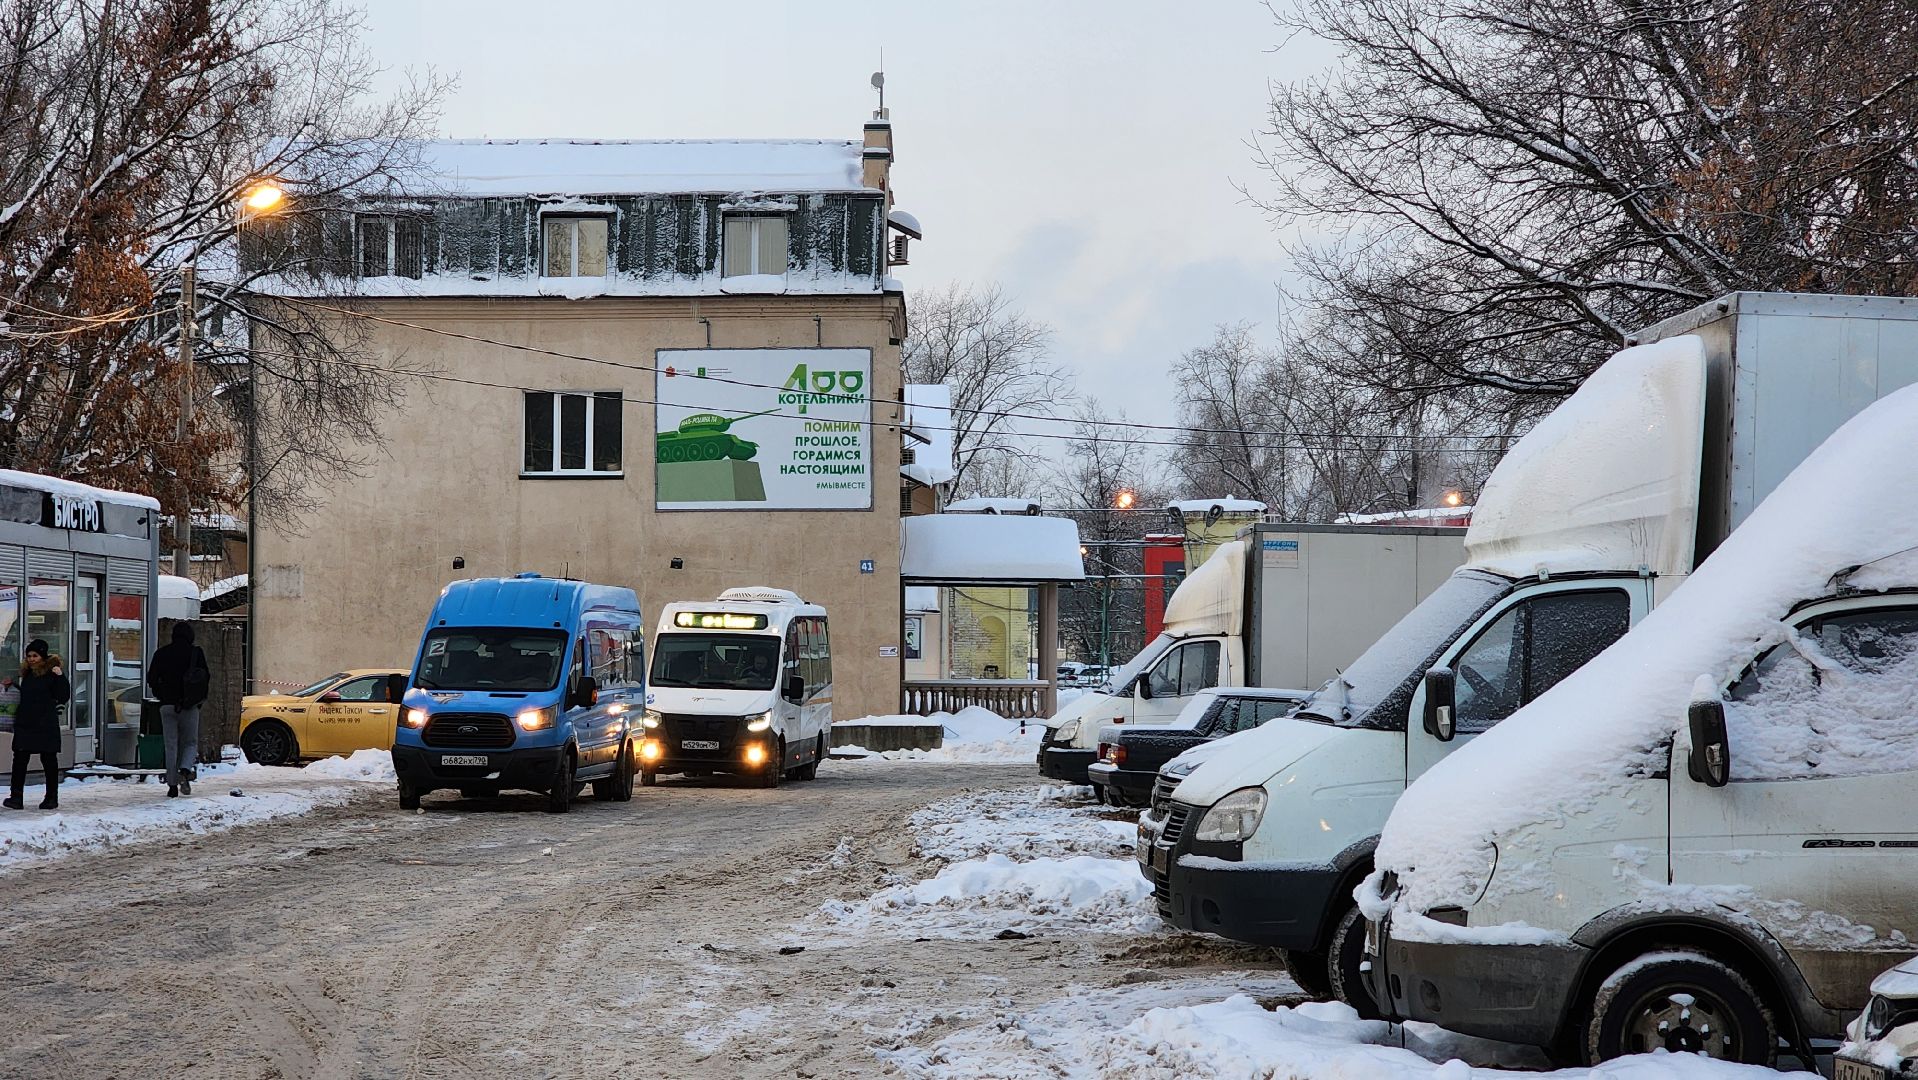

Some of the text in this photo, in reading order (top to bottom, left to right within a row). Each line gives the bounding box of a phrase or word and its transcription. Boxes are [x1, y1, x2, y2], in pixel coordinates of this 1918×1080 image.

[778, 393, 864, 404] КОТЕЛЬНИКИ
[804, 422, 861, 432] ПОМНИМ
[795, 435, 861, 447] ПРОШЛОЕ,
[793, 450, 861, 461] ГОРДИМСЯ
[780, 464, 865, 475] НАСТОЯЩИМ!
[816, 481, 866, 489] #МЫВМЕСТЕ
[54, 497, 99, 531] БИСТРО
[861, 562, 874, 571] 41
[319, 705, 363, 715] Яндекс Такси
